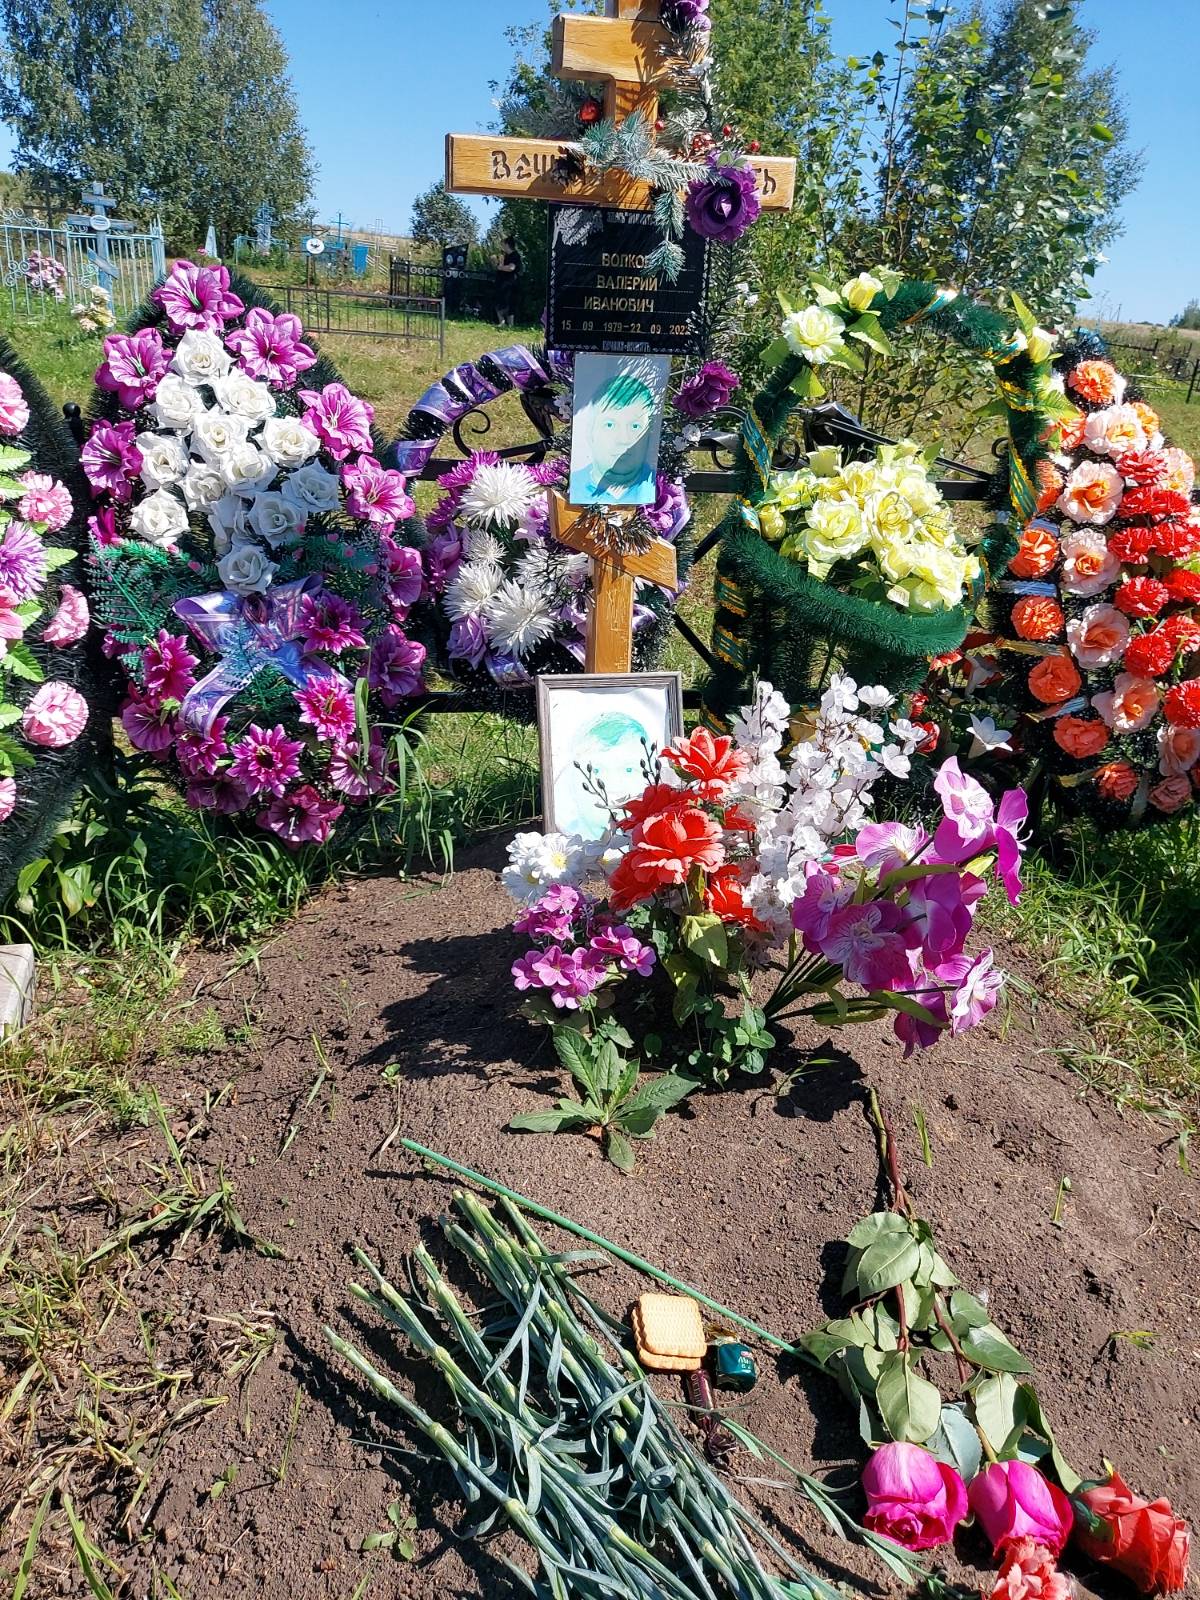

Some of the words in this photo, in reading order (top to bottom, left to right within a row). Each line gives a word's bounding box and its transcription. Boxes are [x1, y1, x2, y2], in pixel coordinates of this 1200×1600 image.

[596, 274, 658, 291] ВАЛЕРИЙ
[583, 295, 655, 313] ИВАНОВИЧ
[561, 319, 572, 331] 15
[582, 320, 594, 331] 09
[650, 323, 662, 334] 09
